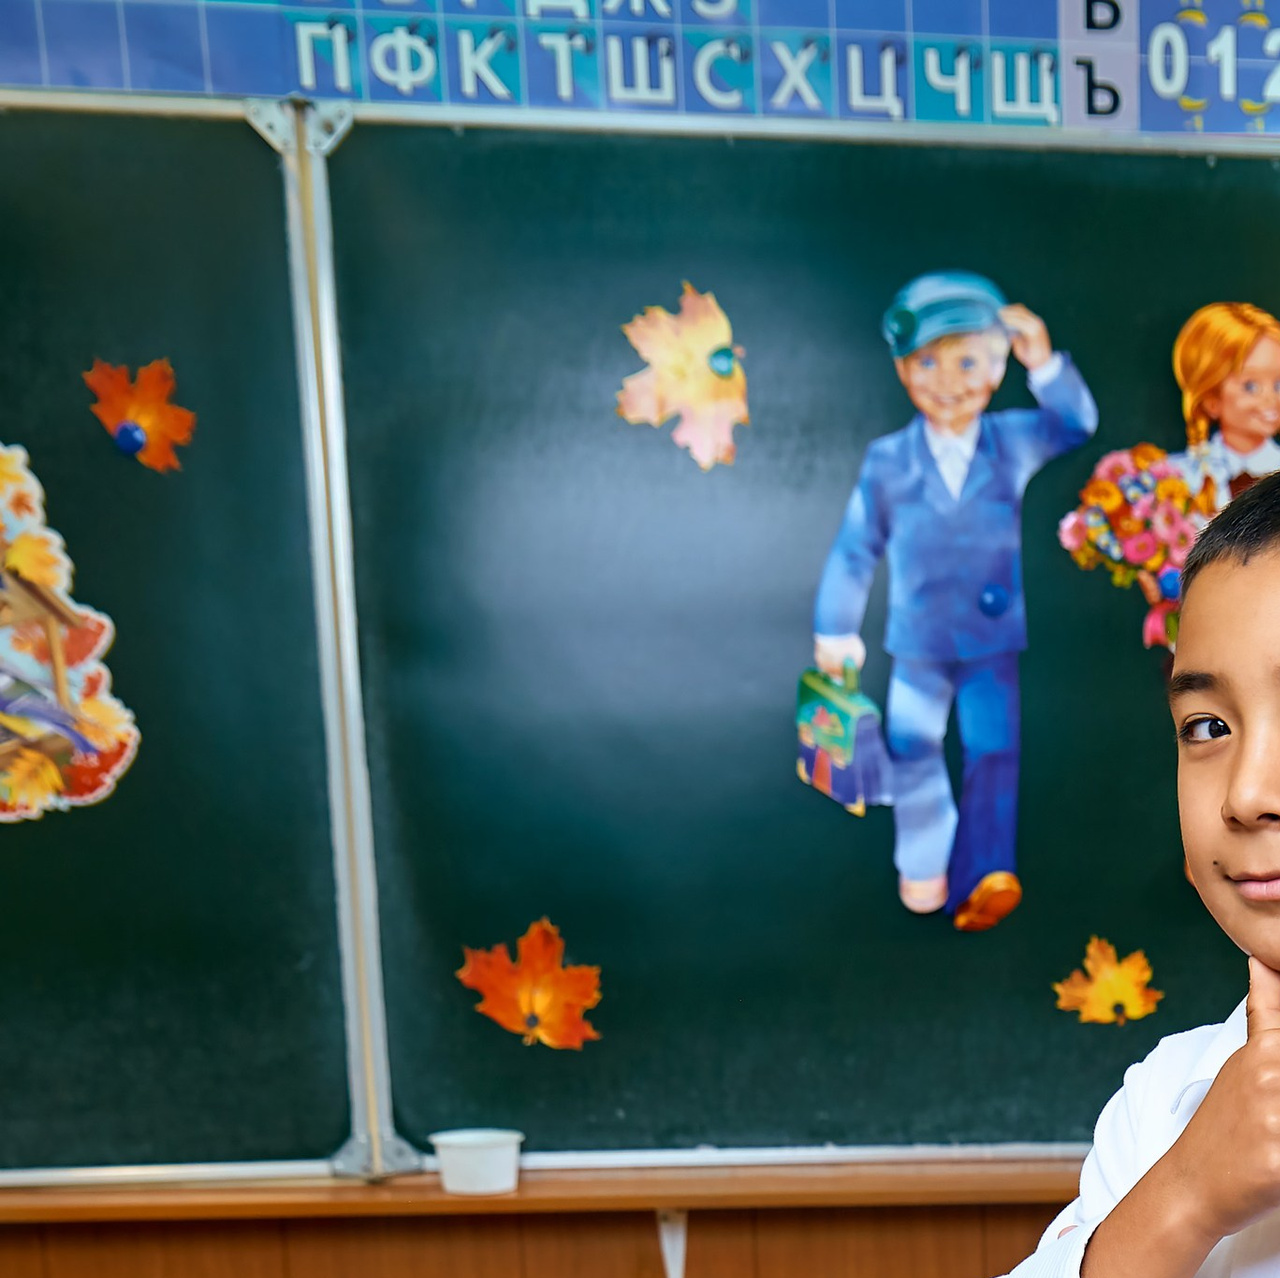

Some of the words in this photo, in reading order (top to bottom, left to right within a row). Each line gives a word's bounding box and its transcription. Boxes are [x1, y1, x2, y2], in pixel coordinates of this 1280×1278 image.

[296, 22, 352, 92] П
[370, 27, 436, 95] Ф
[458, 30, 511, 99] К
[538, 33, 586, 101] Т
[606, 35, 676, 104] Ш
[693, 39, 743, 109] С
[770, 41, 823, 110] Х
[846, 44, 905, 121] Ц
[923, 46, 972, 116] Ч
[990, 50, 1060, 126] Щ
[1074, 59, 1122, 116] Ъ
[1149, 22, 1187, 98] 0
[1208, 25, 1237, 101] 1
